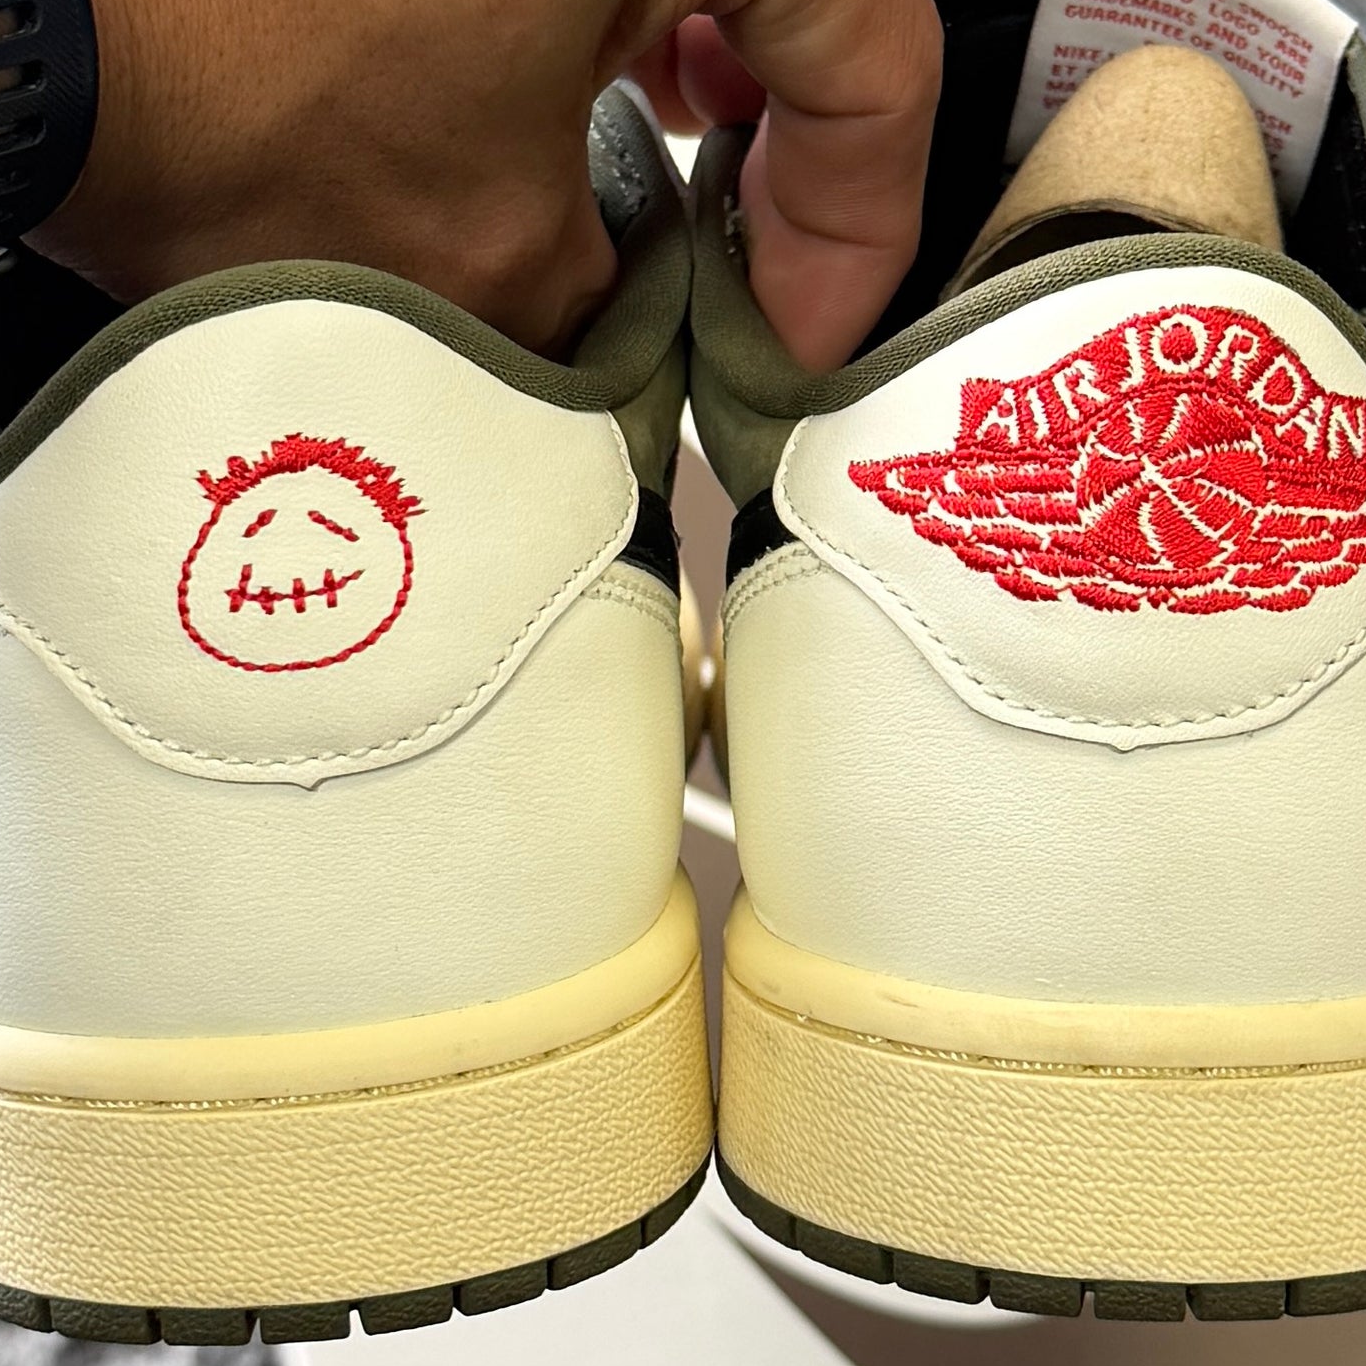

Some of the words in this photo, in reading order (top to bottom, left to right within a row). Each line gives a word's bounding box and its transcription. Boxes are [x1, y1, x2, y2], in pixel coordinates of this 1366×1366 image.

[1053, 44, 1102, 62] NIKE
[1064, 4, 1184, 42] GUARANTEE
[1190, 35, 1215, 52] OF
[1222, 50, 1304, 100] QUALITY
[1206, 23, 1248, 50] AND
[1256, 45, 1306, 84] YOUR
[1208, 2, 1260, 36] LOGO
[1275, 39, 1308, 67] ARE
[1238, 2, 1314, 54] SWOOSH
[975, 357, 1112, 445] AIR
[1119, 311, 1366, 461] JORDAN
